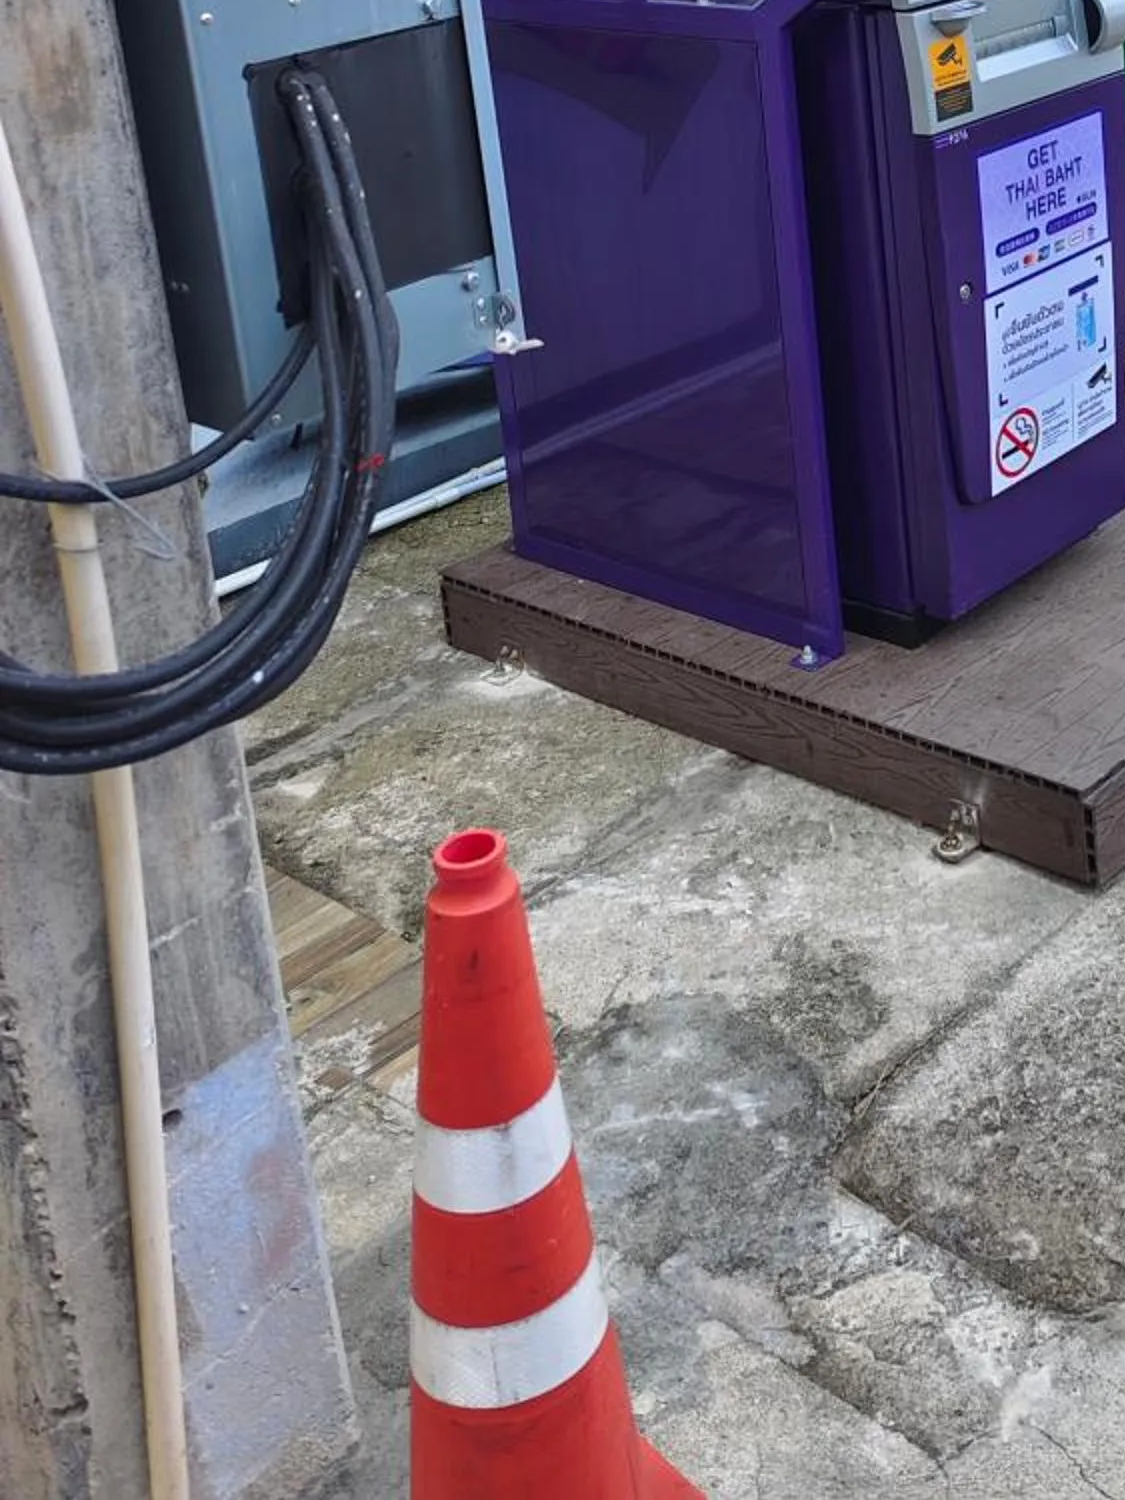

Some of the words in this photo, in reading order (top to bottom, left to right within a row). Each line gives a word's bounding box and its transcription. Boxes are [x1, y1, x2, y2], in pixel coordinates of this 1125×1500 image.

[1027, 139, 1059, 170] GET
[1005, 175, 1040, 204] THAI
[1045, 156, 1083, 188] BAHT
[1025, 187, 1067, 220] HERE
